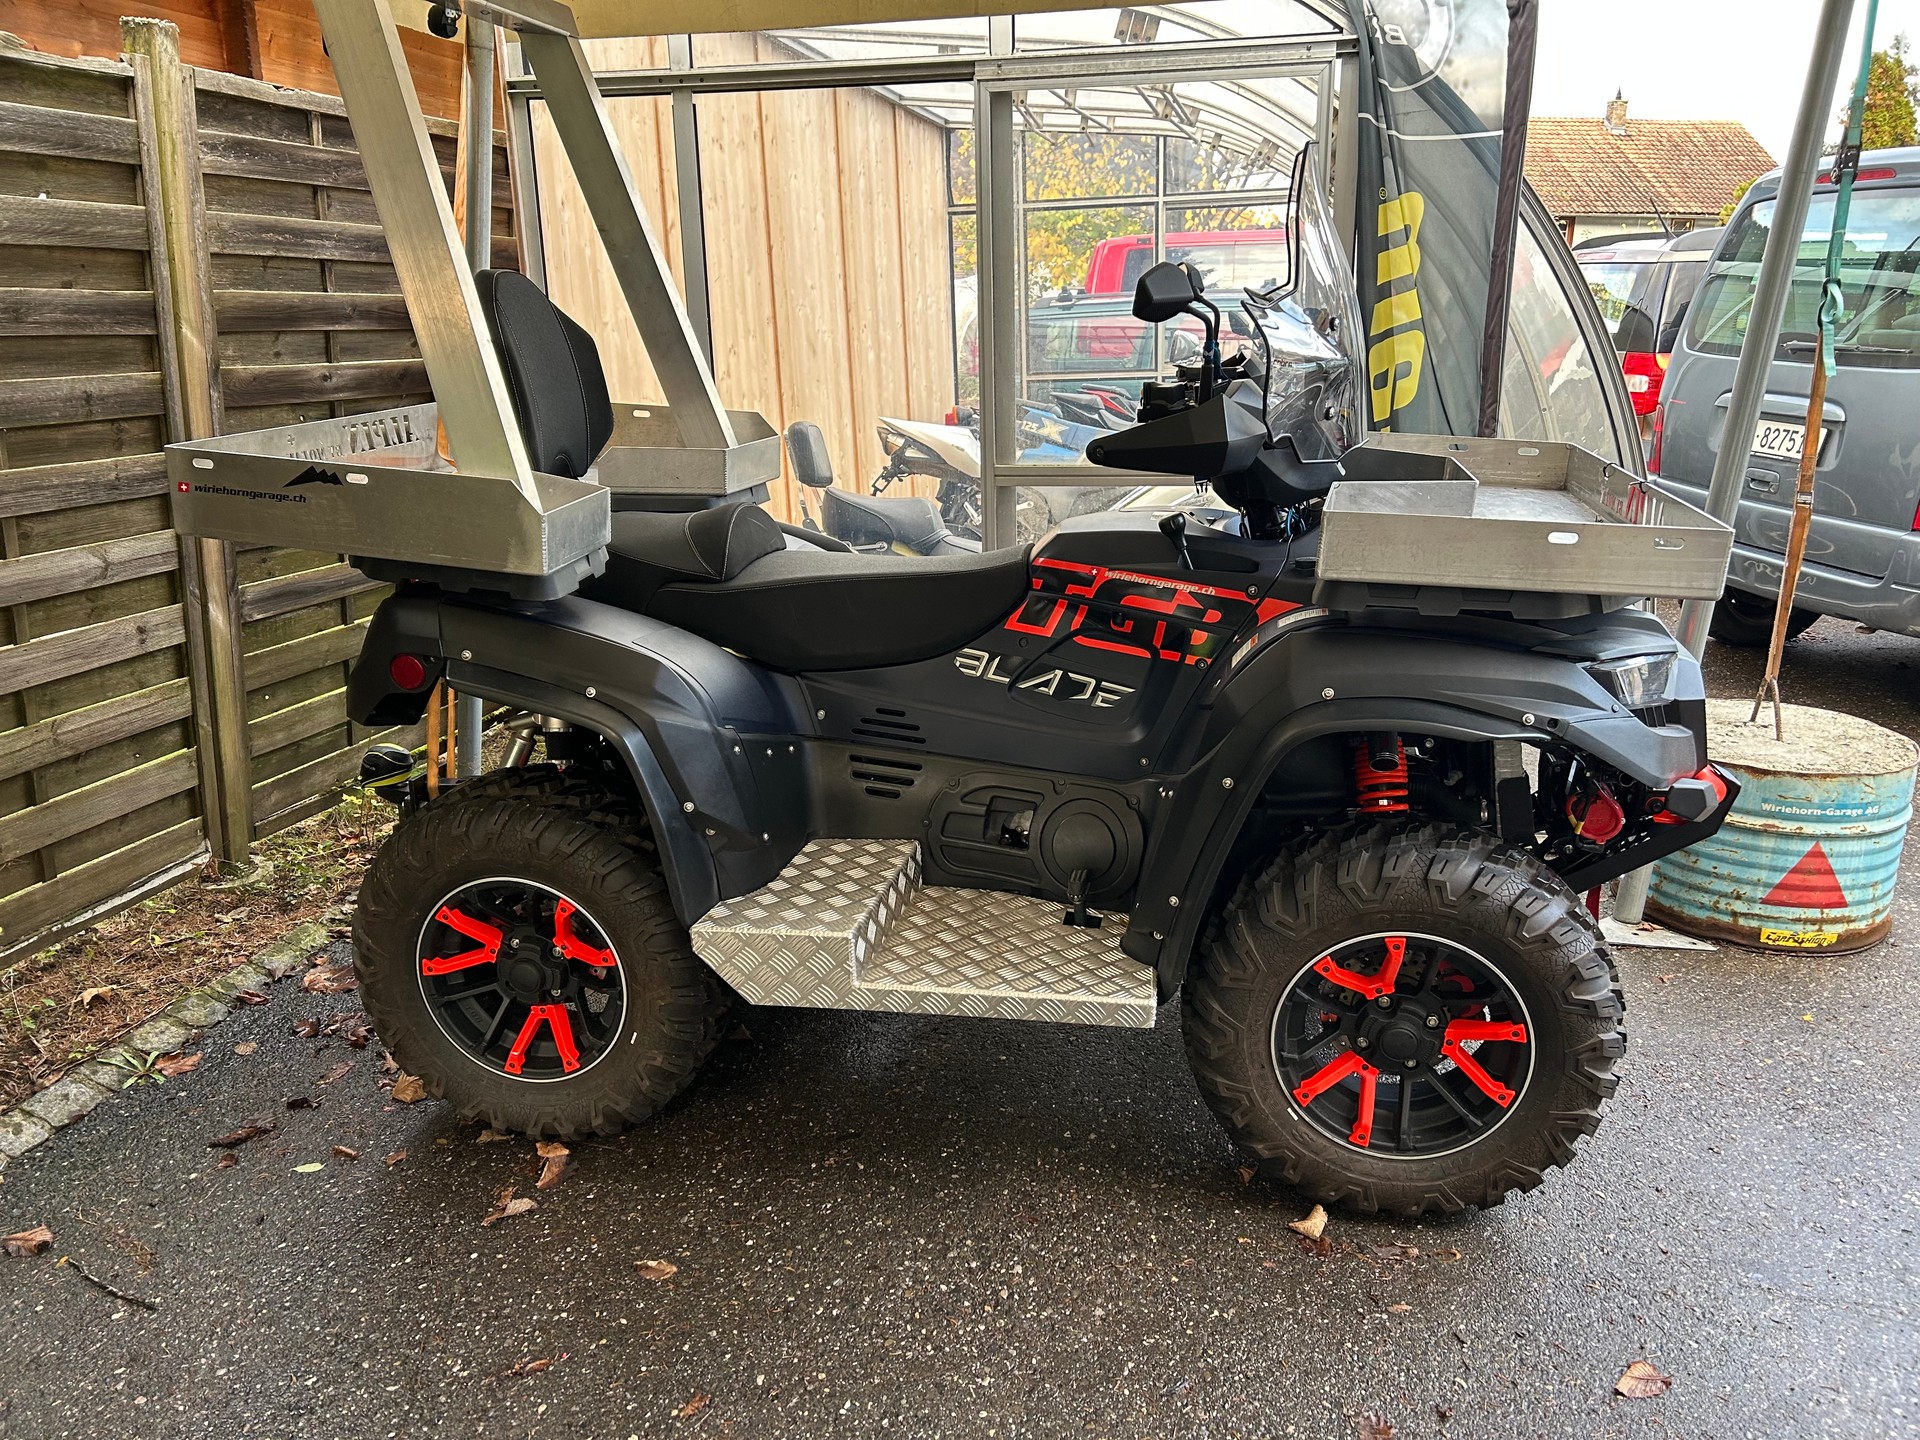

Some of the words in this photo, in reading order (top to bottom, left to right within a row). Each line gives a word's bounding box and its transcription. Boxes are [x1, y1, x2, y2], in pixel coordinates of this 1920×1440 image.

[194, 483, 307, 503] wiriehorngarage.ch
[1104, 569, 1216, 596] wiriehorngarage.ch
[953, 647, 1136, 708] BLADE
[1761, 802, 1864, 817] Wiriehorn-Garage
[1865, 805, 1880, 816] AG
